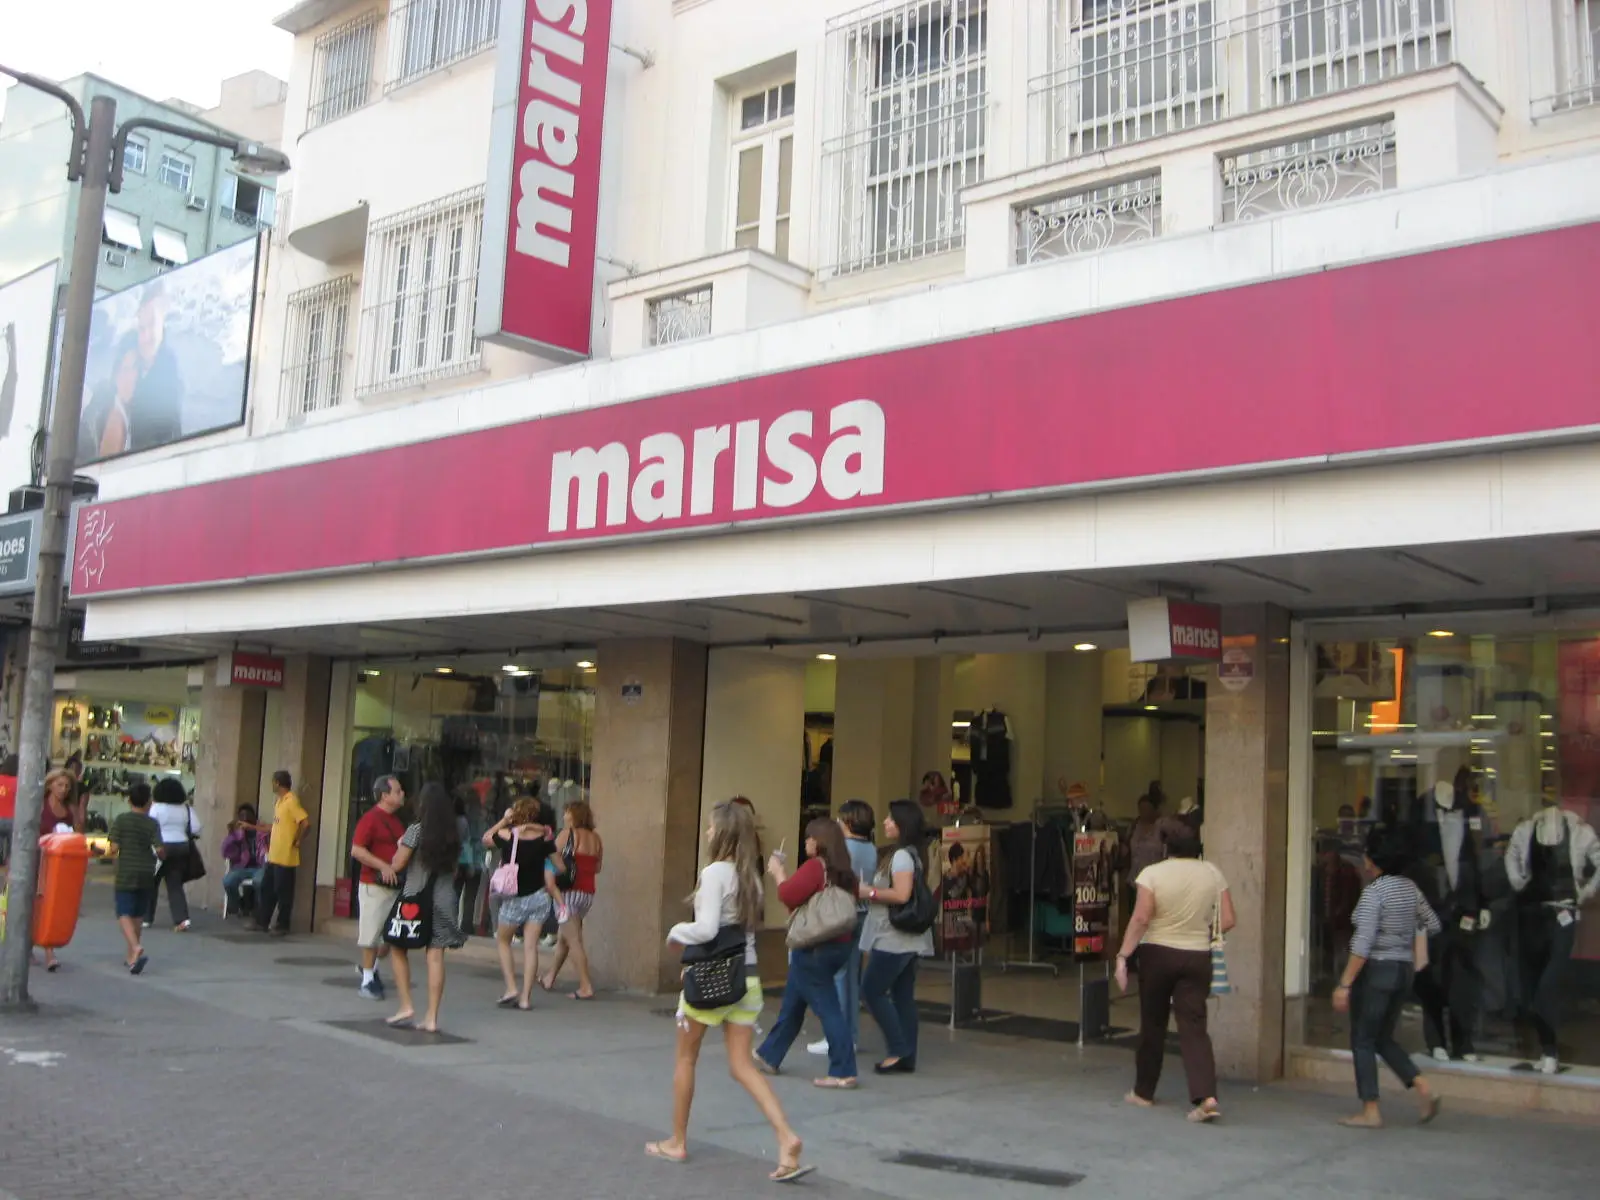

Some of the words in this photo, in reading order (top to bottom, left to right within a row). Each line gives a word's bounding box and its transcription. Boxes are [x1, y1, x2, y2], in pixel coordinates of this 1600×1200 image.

[548, 398, 886, 533] marisa
[0, 536, 26, 557] oes
[1172, 624, 1219, 648] marisa
[234, 665, 282, 682] marisa
[1075, 886, 1096, 903] 100
